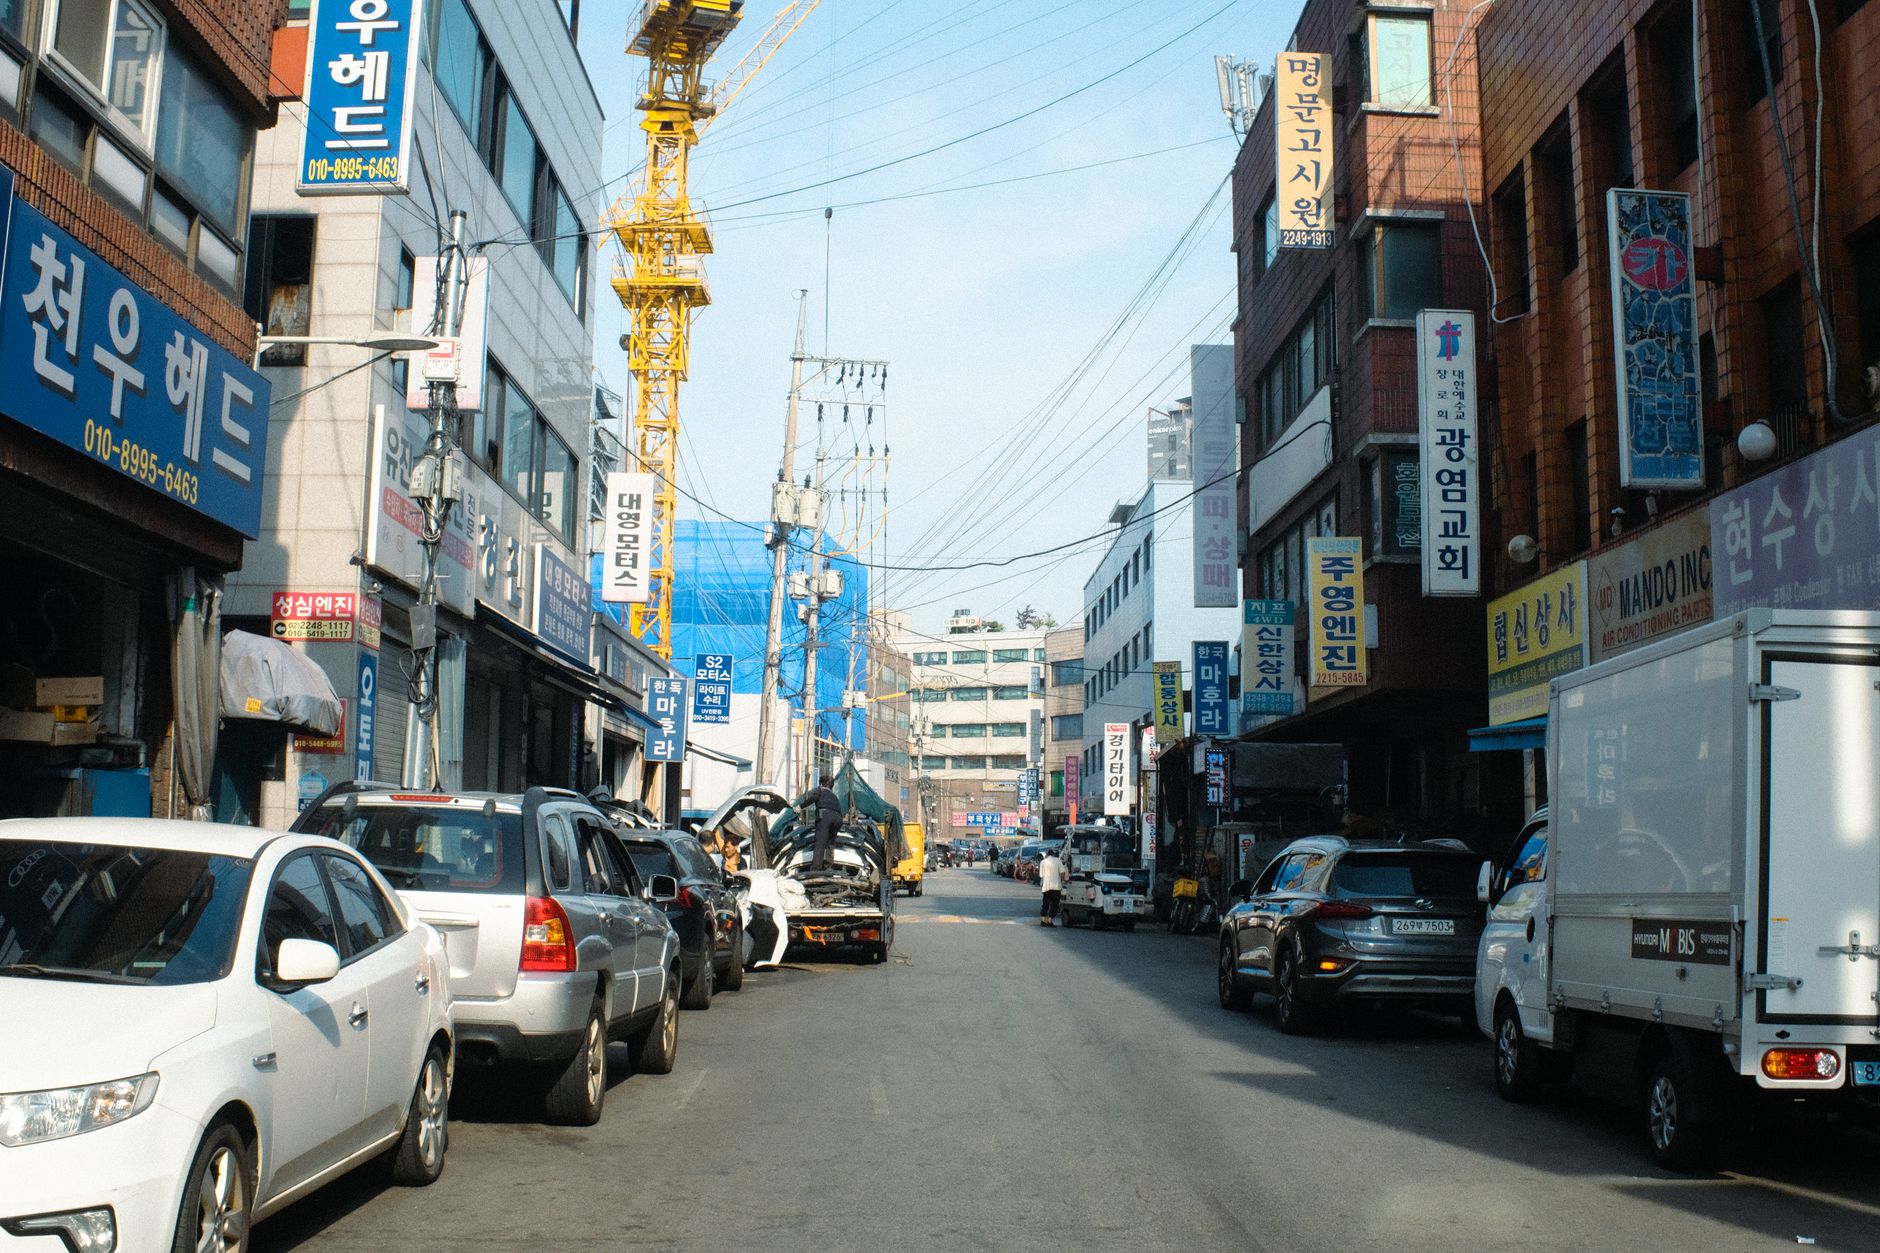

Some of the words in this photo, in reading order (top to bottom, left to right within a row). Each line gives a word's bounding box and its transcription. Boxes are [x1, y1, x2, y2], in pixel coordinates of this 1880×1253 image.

[1286, 56, 1323, 228] 명문고시원
[308, 157, 398, 180] 010-8995-6463
[1283, 231, 1332, 247] 2249-1913
[22, 233, 254, 482] 천우헤드
[1435, 369, 1449, 420] 장로회
[1452, 369, 1466, 420] 대한예수교
[84, 418, 199, 505] 010-8995-6463
[1435, 428, 1471, 580] 광염교회
[614, 493, 641, 587] 대영모터스
[275, 596, 353, 617] 성심엔진
[544, 556, 588, 612] 대영모터스
[1619, 559, 1677, 620] MANDO
[288, 621, 350, 630] 02)2248-1117
[288, 630, 349, 638] 010-5419-1117
[1253, 616, 1284, 624] 4WD
[1320, 556, 1357, 671] 주영엔진
[1602, 630, 1615, 649] AIR
[1616, 608, 1680, 644] CONDITIONING
[1681, 596, 1713, 623] PARTS
[696, 669, 731, 681] 모터스
[705, 656, 723, 669] S2
[1198, 646, 1225, 659] 한국
[1255, 626, 1286, 691] 신한상사
[1316, 672, 1364, 684] 2215-5845
[654, 680, 682, 694] 한독
[699, 685, 726, 695] 라이트
[703, 695, 722, 705] 수리
[1160, 672, 1179, 727] 합동상사
[1200, 664, 1223, 729] 마후라
[653, 697, 677, 760] 마후라
[1109, 734, 1125, 802] 경기타이어
[1424, 921, 1451, 932] 7503
[1633, 933, 1659, 946] HYUNDAI
